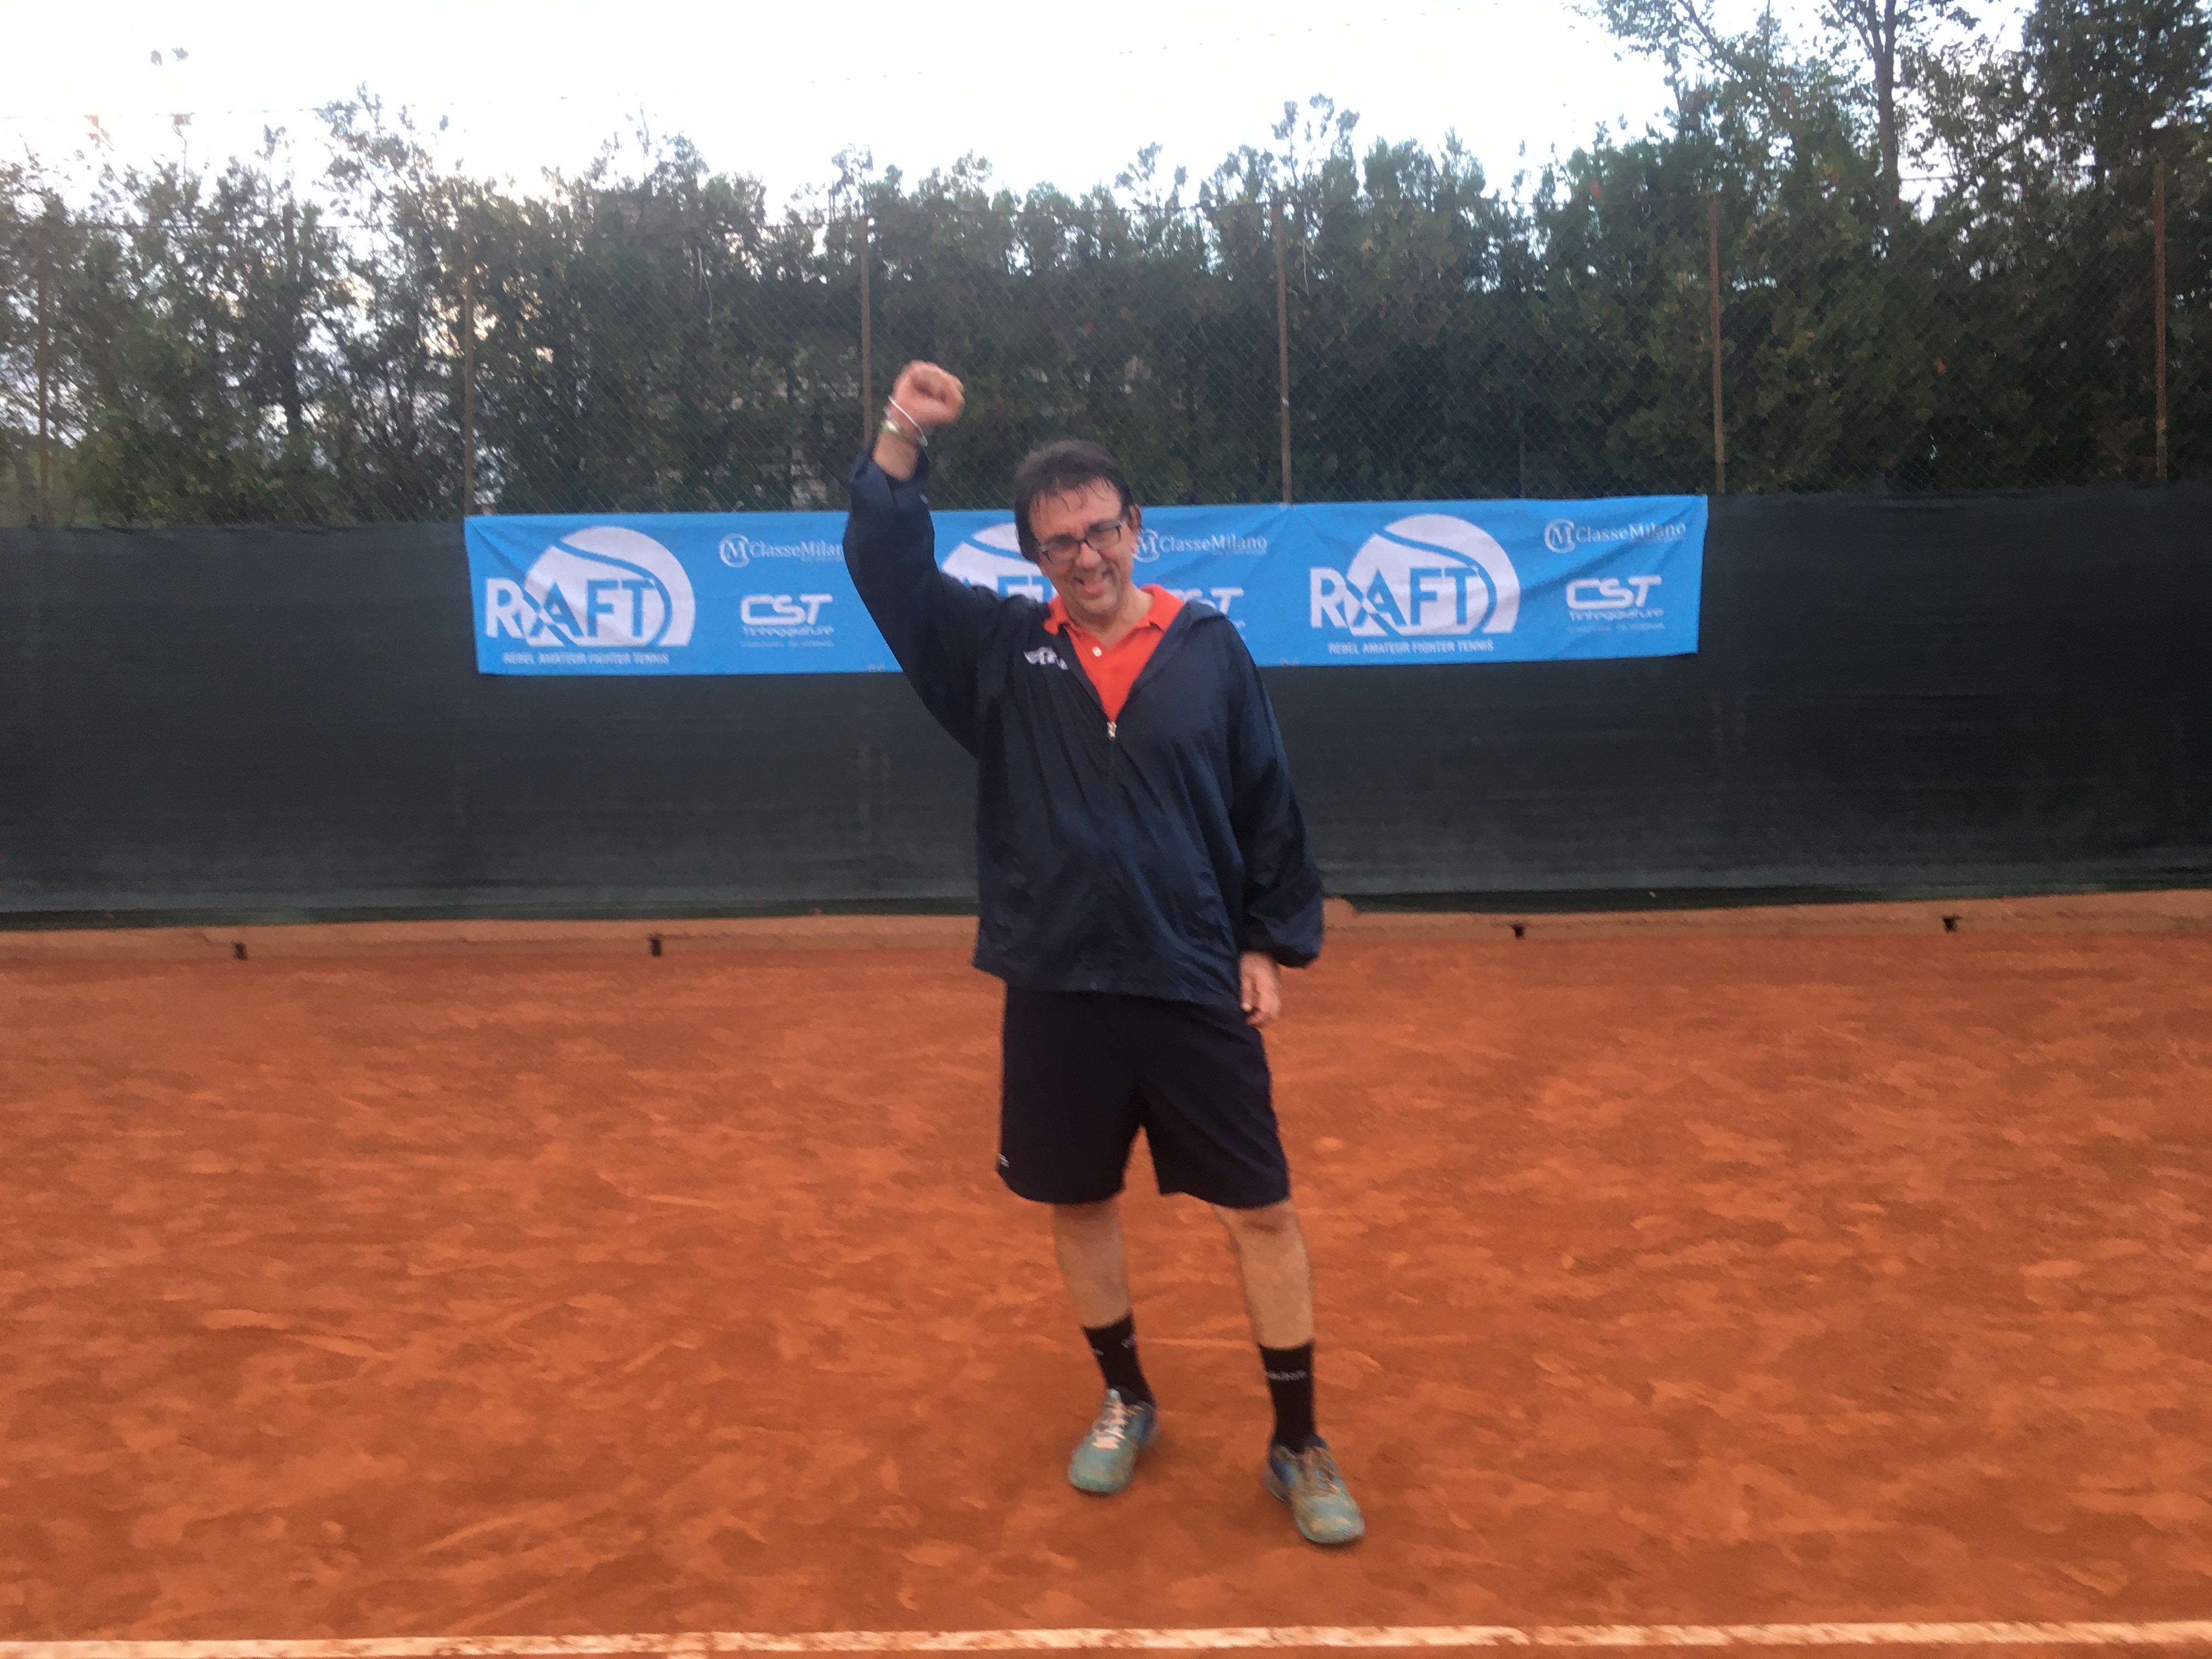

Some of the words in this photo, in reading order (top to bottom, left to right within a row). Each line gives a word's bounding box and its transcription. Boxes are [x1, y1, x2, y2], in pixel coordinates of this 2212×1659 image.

[1159, 533, 1267, 552] ClasseMilano
[1575, 522, 1686, 543] ClasseMilano
[749, 540, 844, 558] ClasseMilan
[1310, 567, 1479, 629] RAFT
[1566, 575, 1662, 610] CST
[486, 578, 655, 638] RAFT
[741, 594, 833, 625] CST
[1457, 638, 1494, 652] TENNIS
